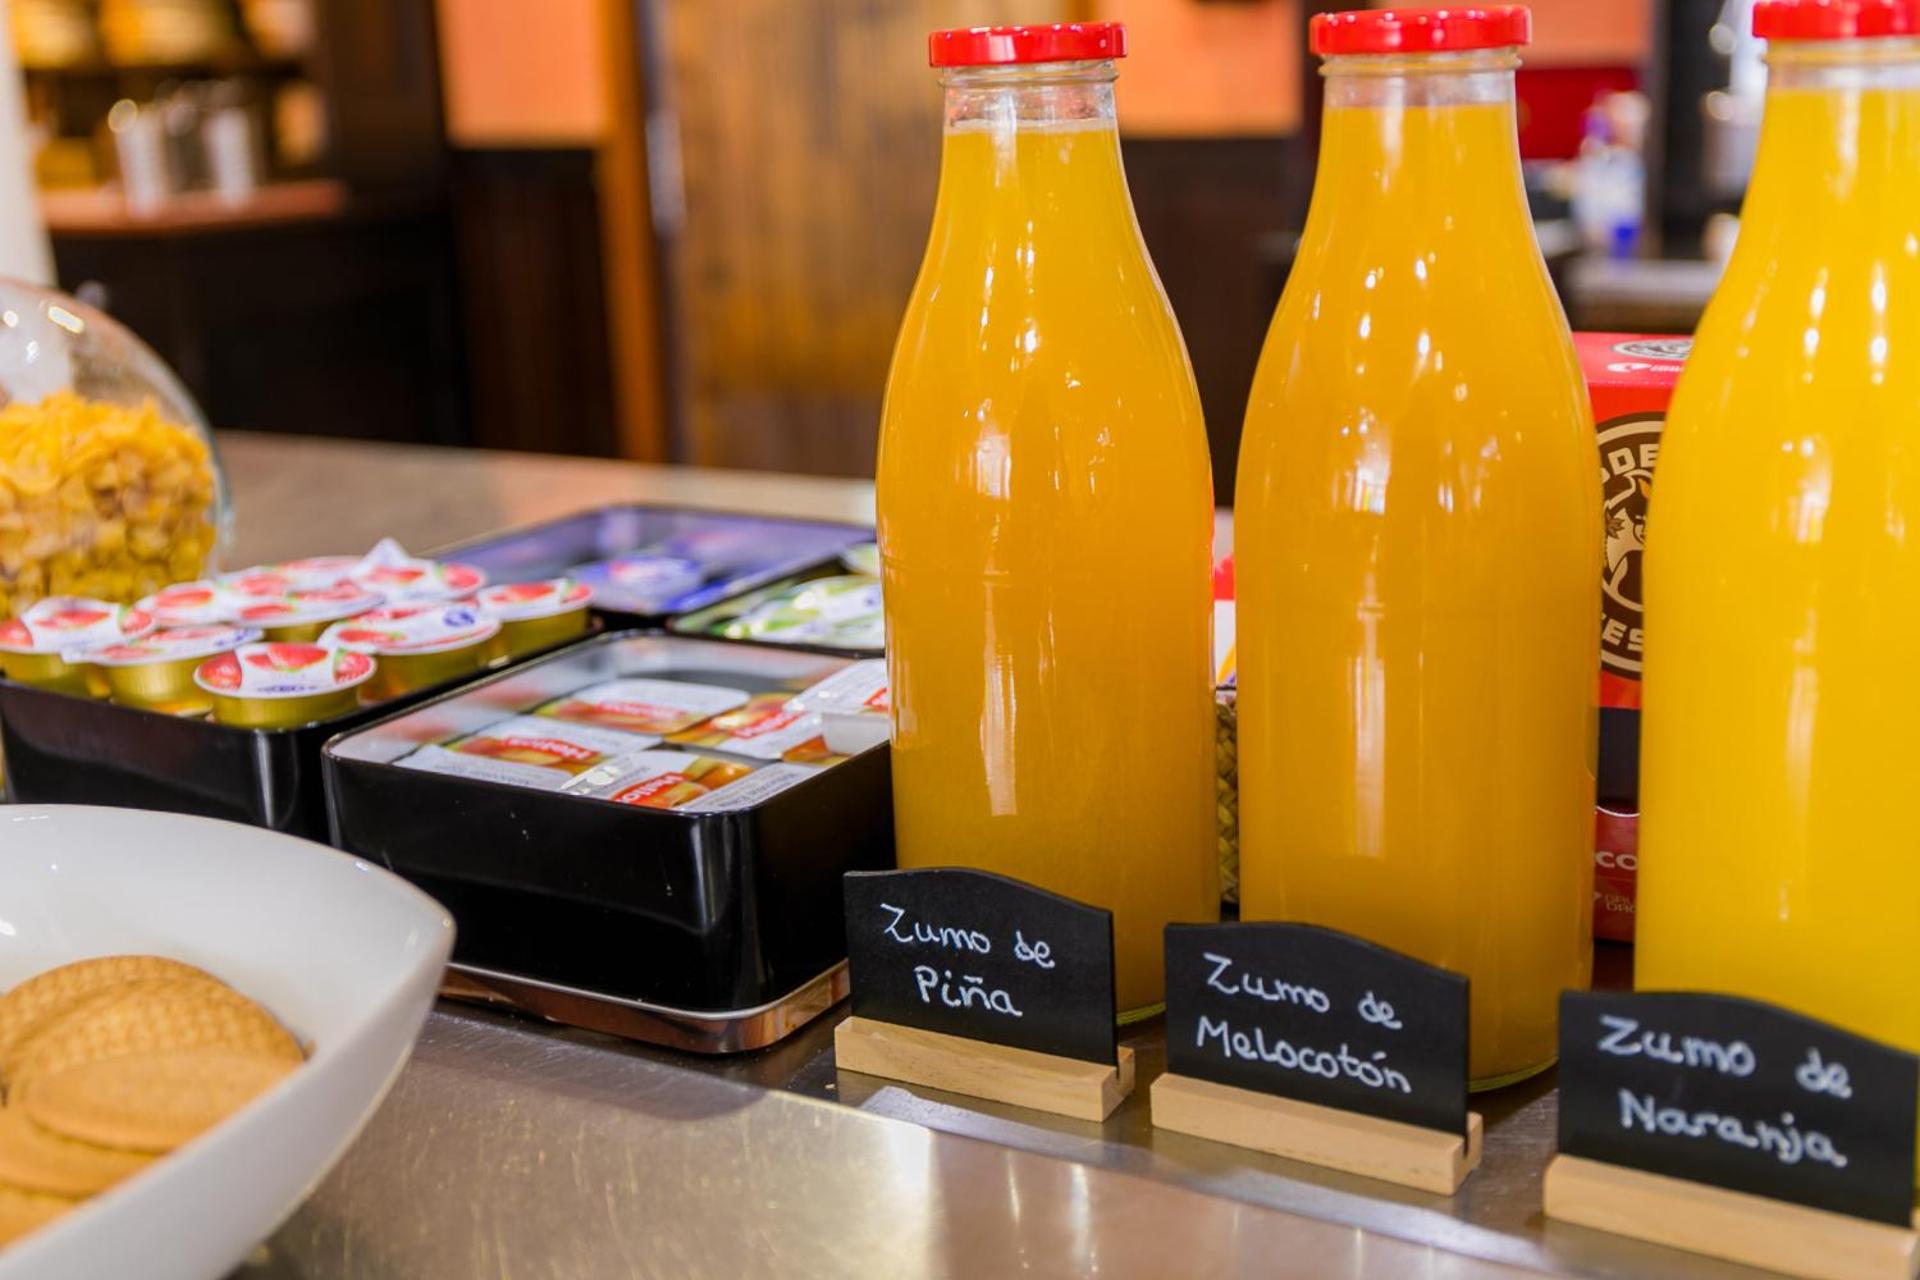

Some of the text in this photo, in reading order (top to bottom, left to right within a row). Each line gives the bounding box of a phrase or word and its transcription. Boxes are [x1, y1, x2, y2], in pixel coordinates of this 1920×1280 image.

[880, 902, 1055, 967] Zumo de
[914, 965, 1023, 1016] Piña
[1203, 952, 1403, 1029] Zumo de
[1196, 1015, 1411, 1093] Melocotón
[1598, 1014, 1852, 1098] Zumo de
[1619, 1088, 1847, 1167] Naranja
